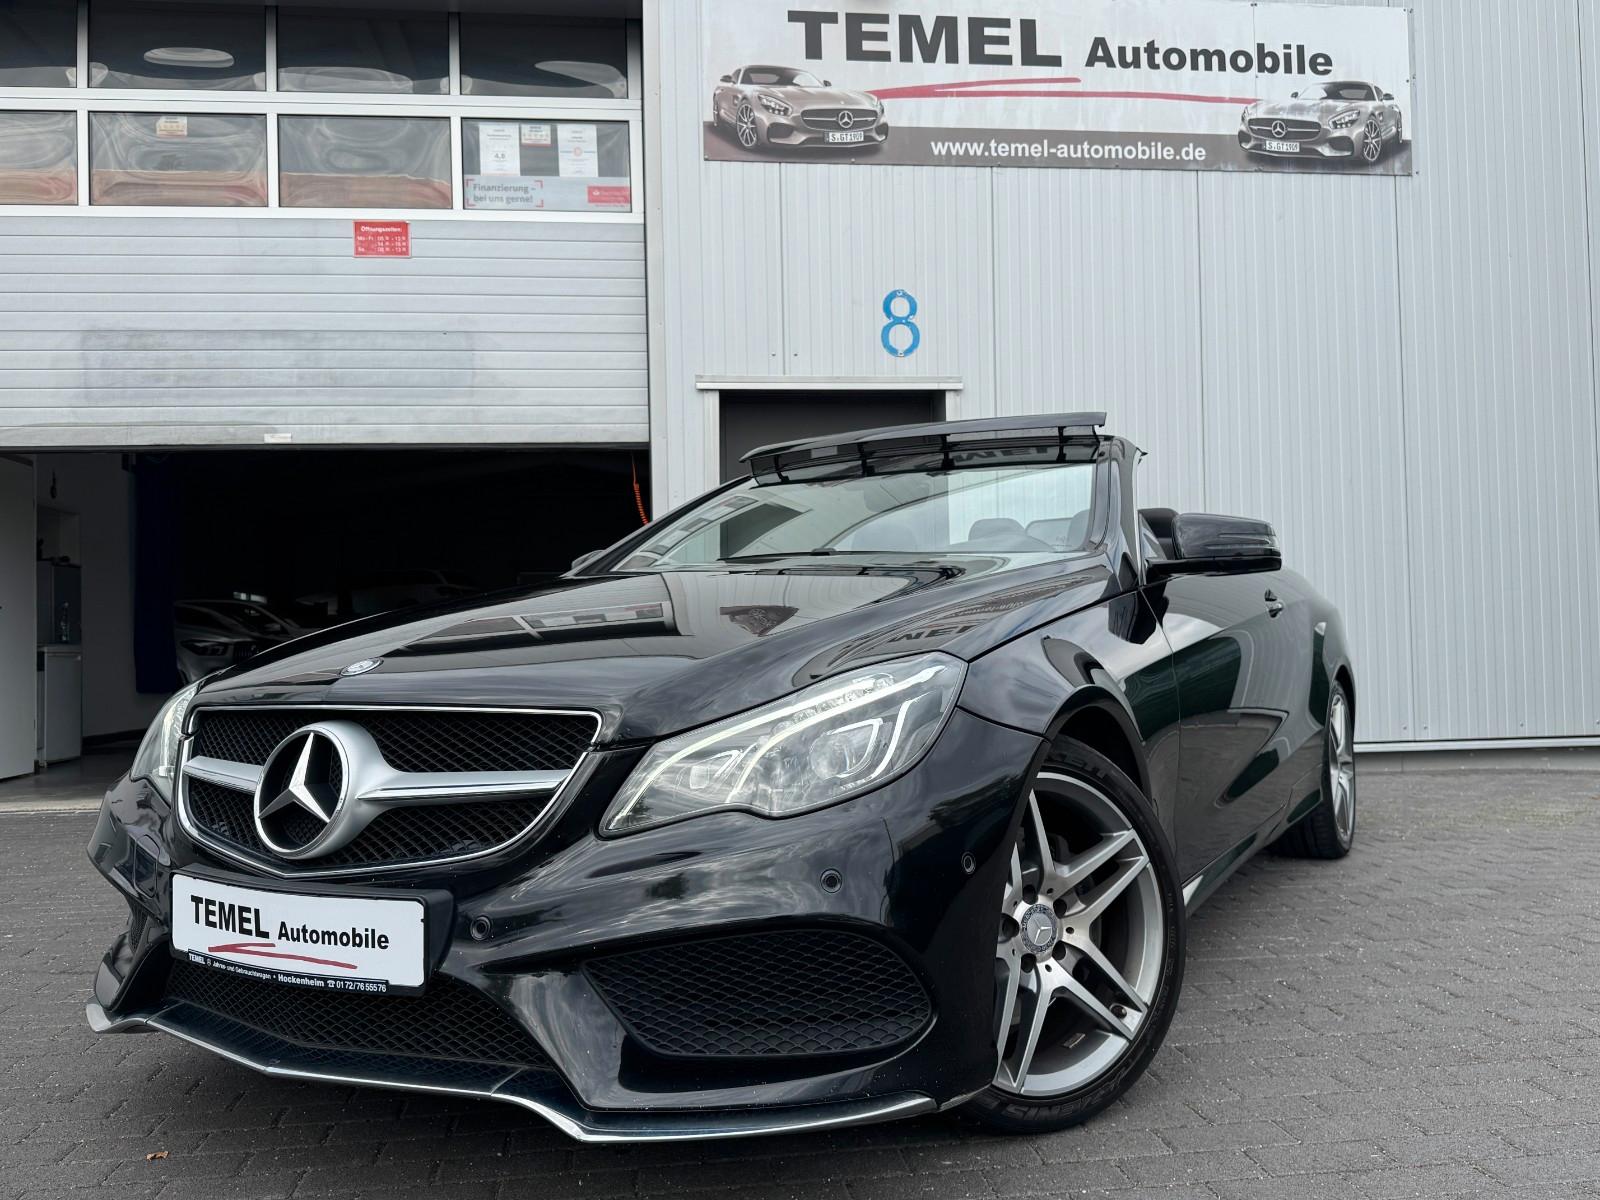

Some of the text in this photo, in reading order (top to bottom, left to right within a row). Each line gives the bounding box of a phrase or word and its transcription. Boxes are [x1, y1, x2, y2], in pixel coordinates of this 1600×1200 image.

[787, 10, 1333, 76] TEMEL Automobile
[931, 138, 1206, 161] www.temel-automobile.de
[473, 184, 529, 195] Finanzierung
[474, 194, 487, 202] bei
[488, 195, 504, 203] uns
[881, 289, 920, 358] 8
[190, 894, 390, 950] TEMEL Automobile
[189, 953, 206, 965] TEMEL
[278, 974, 324, 987] Hockenheim
